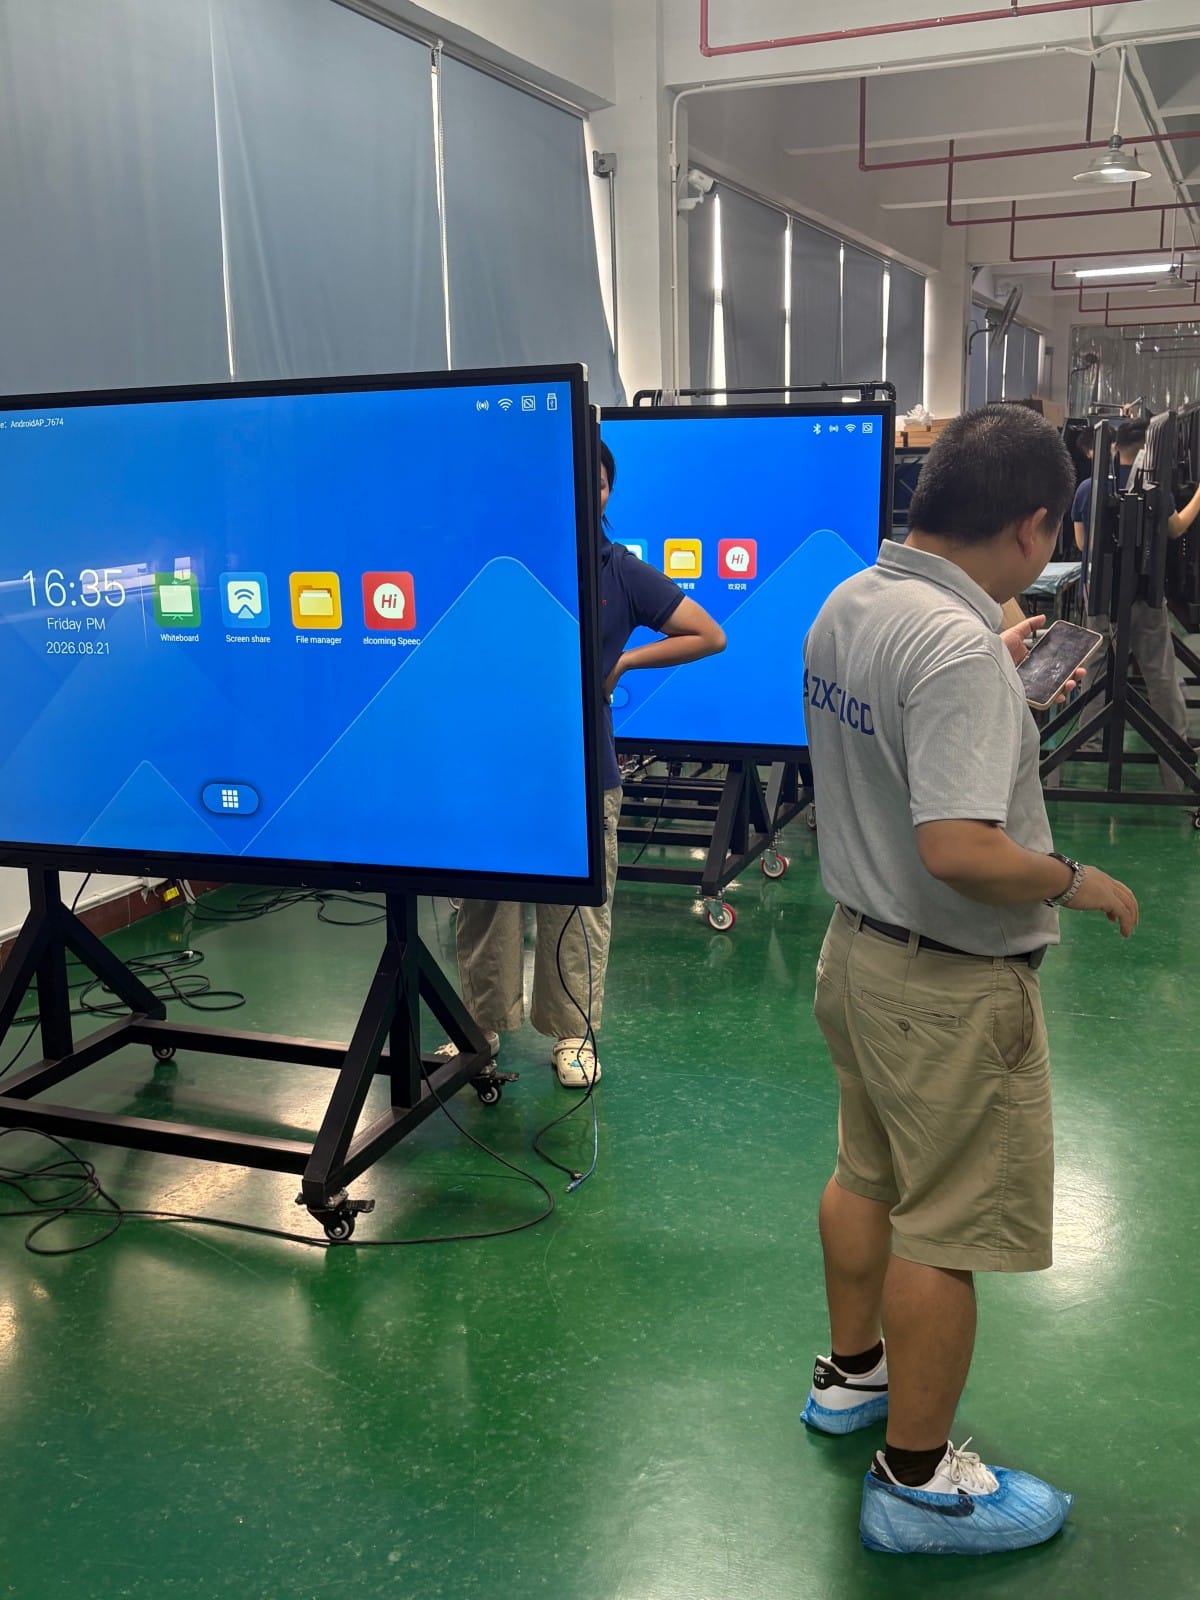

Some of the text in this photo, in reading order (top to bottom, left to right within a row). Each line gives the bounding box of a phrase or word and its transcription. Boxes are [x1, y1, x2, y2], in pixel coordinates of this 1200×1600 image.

[10, 417, 64, 428] AndroidAP_7674
[731, 553, 744, 565] Hi
[22, 569, 126, 607] 16:35
[381, 594, 398, 609] Hi
[47, 617, 106, 633] Friday PM
[160, 633, 199, 643] Whiteboard
[225, 634, 271, 644] Screen share
[296, 635, 342, 647] File manager
[46, 641, 110, 655] 2026.08.21
